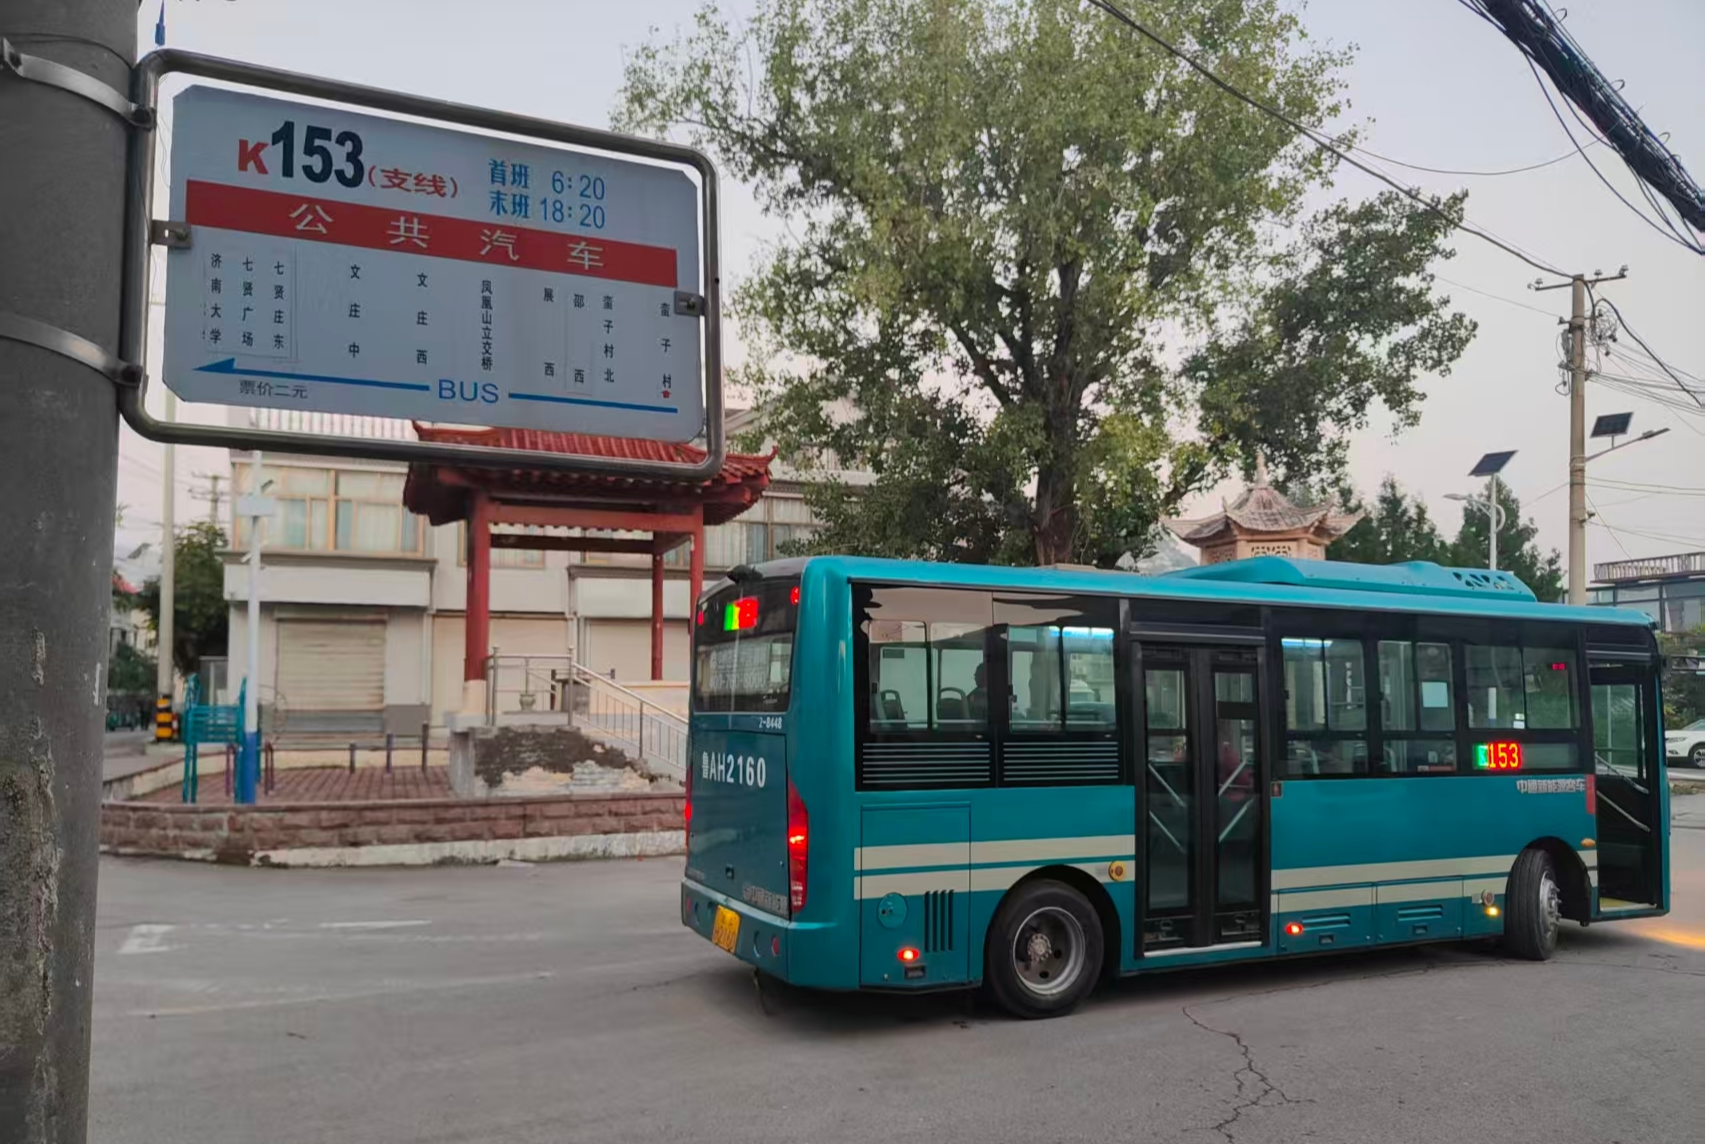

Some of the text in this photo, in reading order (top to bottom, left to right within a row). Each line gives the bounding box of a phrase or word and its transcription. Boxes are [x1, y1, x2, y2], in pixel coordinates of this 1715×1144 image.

[238, 120, 365, 188] K153
[488, 158, 605, 200] 首班 6:20
[289, 203, 603, 270] 公共汽车
[488, 189, 605, 229] 末班 18:20
[209, 253, 222, 344] 济南大学
[242, 256, 254, 347] 七贤广场
[273, 261, 285, 349] 七贤庄东
[348, 264, 361, 358] 文庄中
[416, 272, 428, 365] 文庄西
[481, 280, 493, 371] 凤凰山立交桥
[239, 380, 308, 399] 票价二元
[438, 379, 499, 403] BUS
[758, 717, 783, 729] 2-8448
